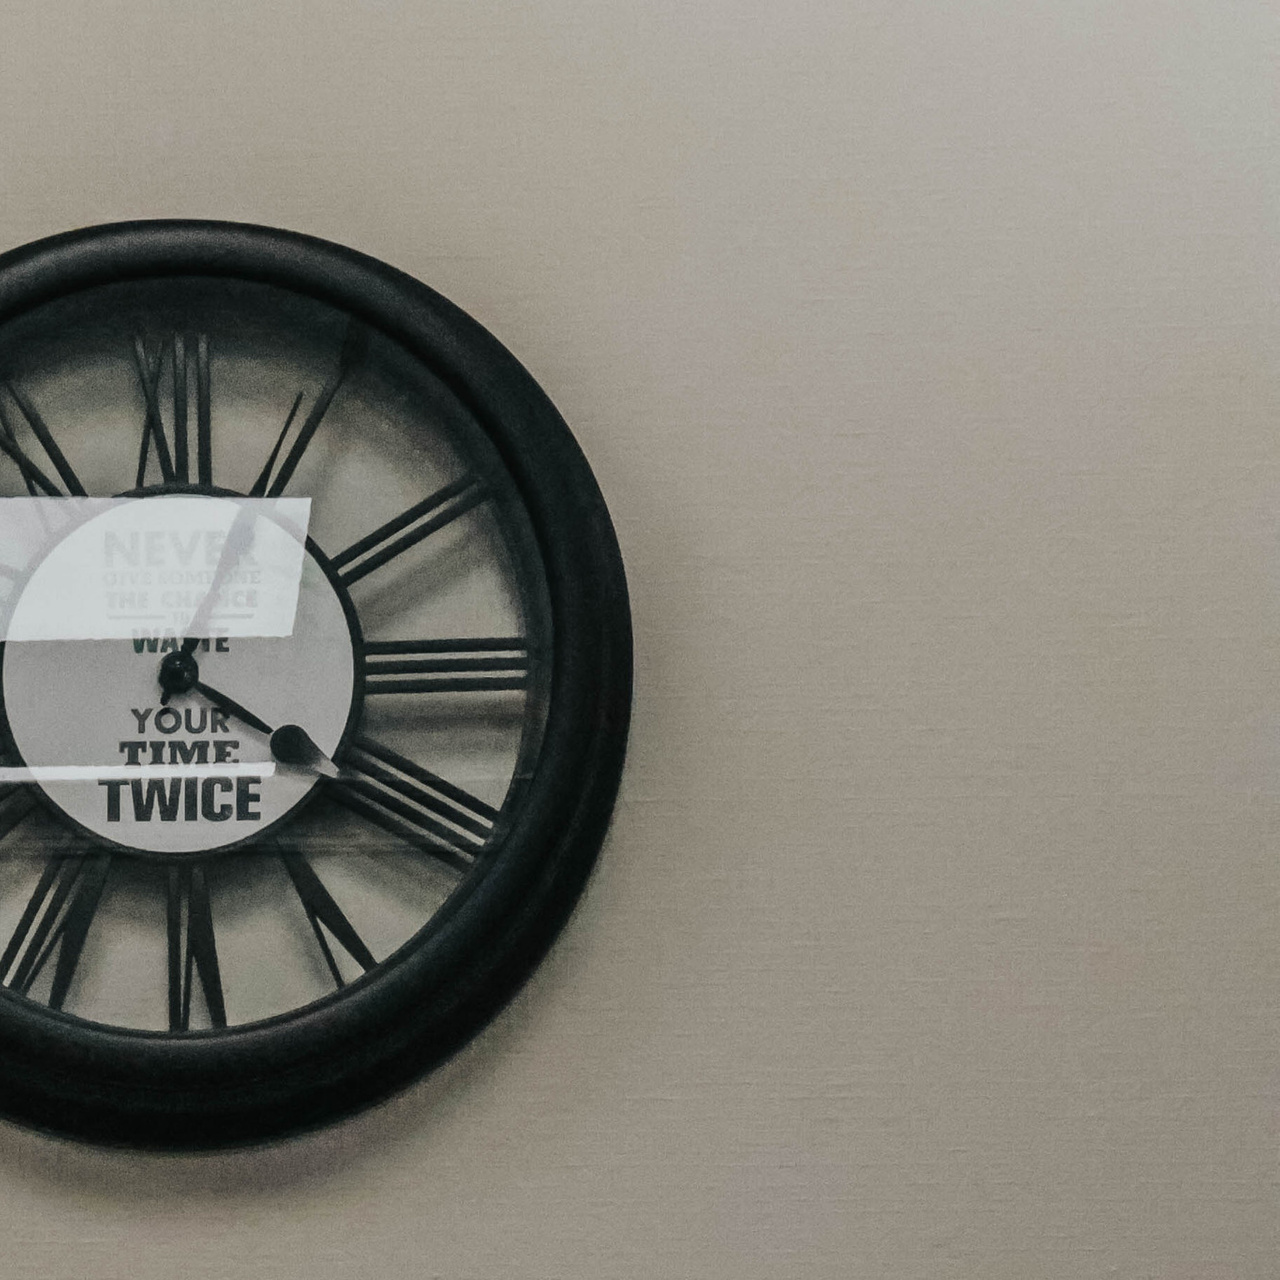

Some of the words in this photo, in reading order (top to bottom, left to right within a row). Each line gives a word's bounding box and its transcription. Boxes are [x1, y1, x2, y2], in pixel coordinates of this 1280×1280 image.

[104, 530, 258, 568] NEVE
[131, 627, 230, 654] WATE
[131, 707, 230, 734] YOUR
[119, 740, 240, 768] TIME
[98, 776, 262, 822] TWICE
